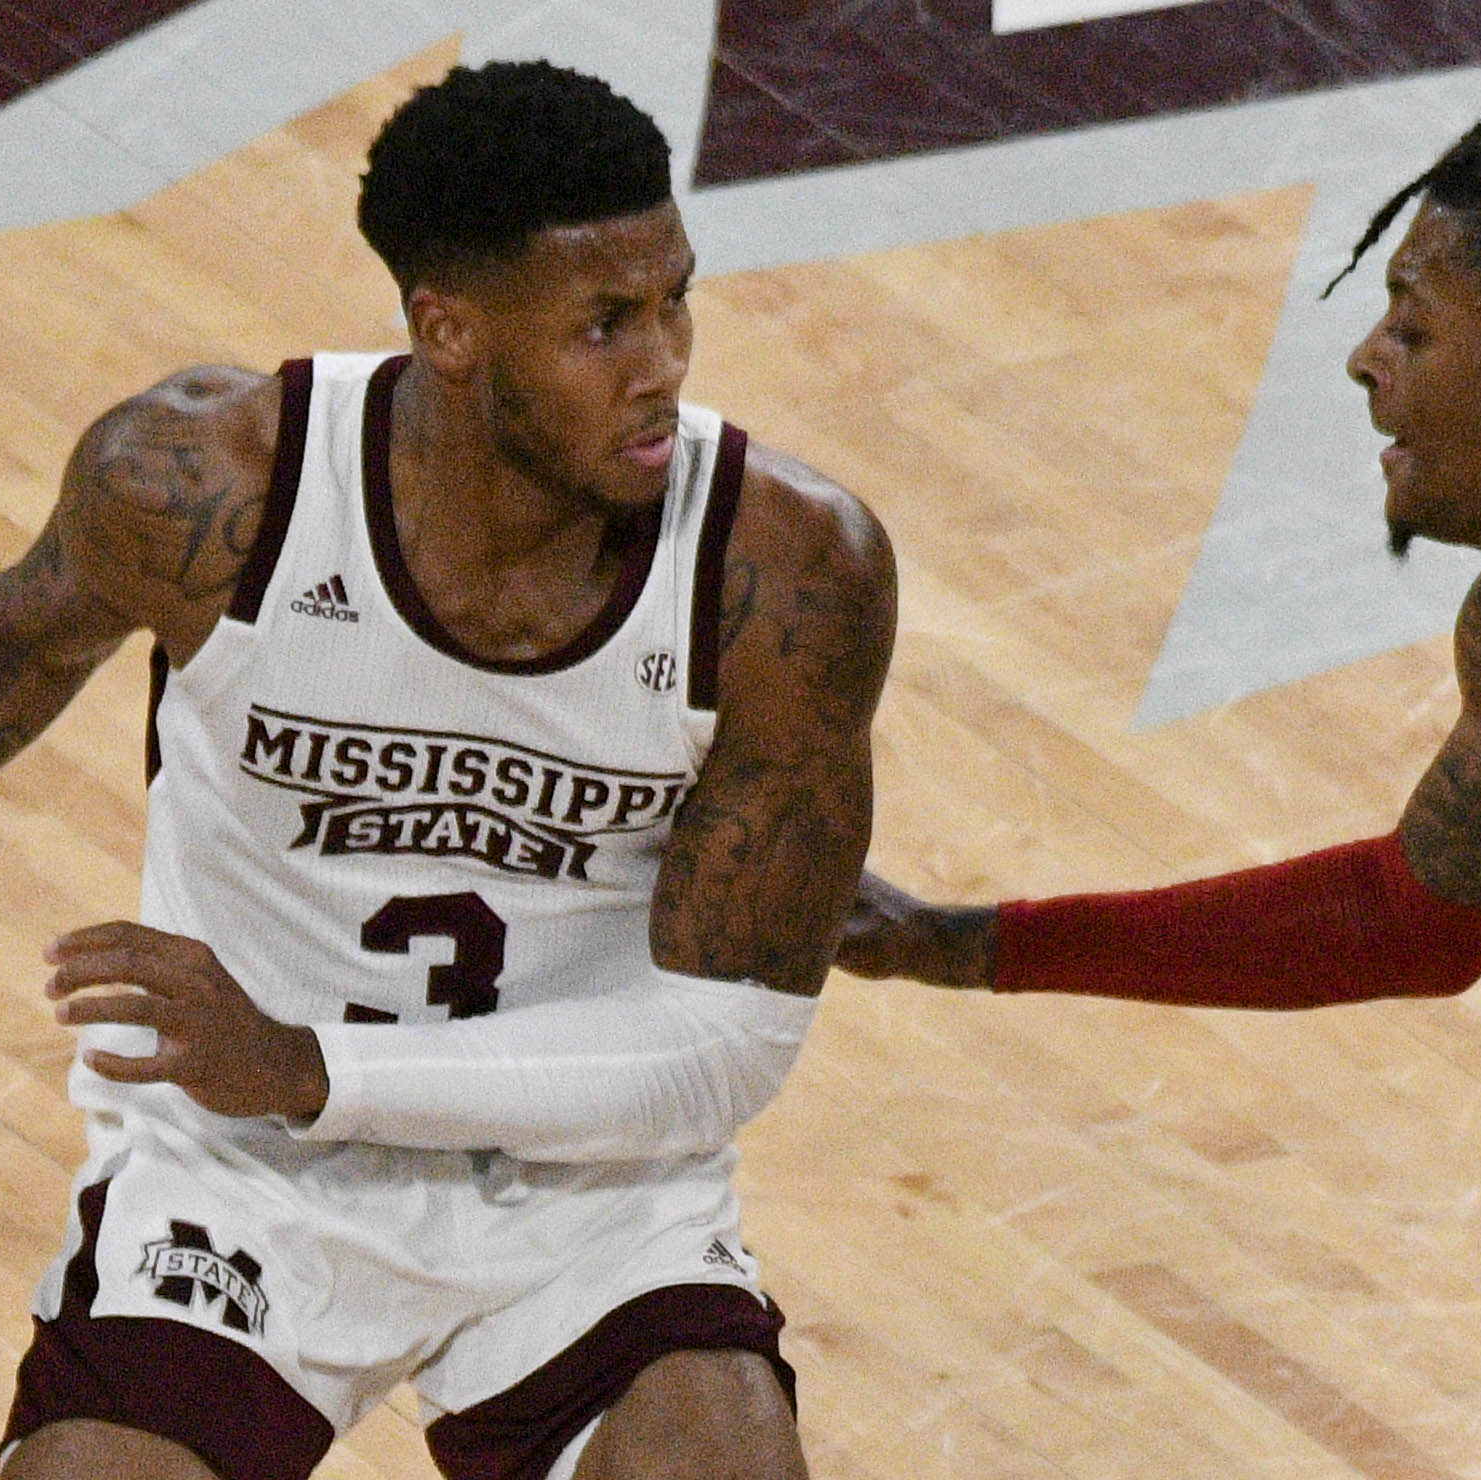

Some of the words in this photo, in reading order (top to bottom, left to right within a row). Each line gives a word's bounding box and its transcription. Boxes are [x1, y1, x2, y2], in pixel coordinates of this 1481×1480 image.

[240, 712, 685, 825] MISSISSIPPI
[344, 808, 548, 870] STATE
[343, 891, 507, 1025] 3
[167, 1252, 253, 1310] STATE
